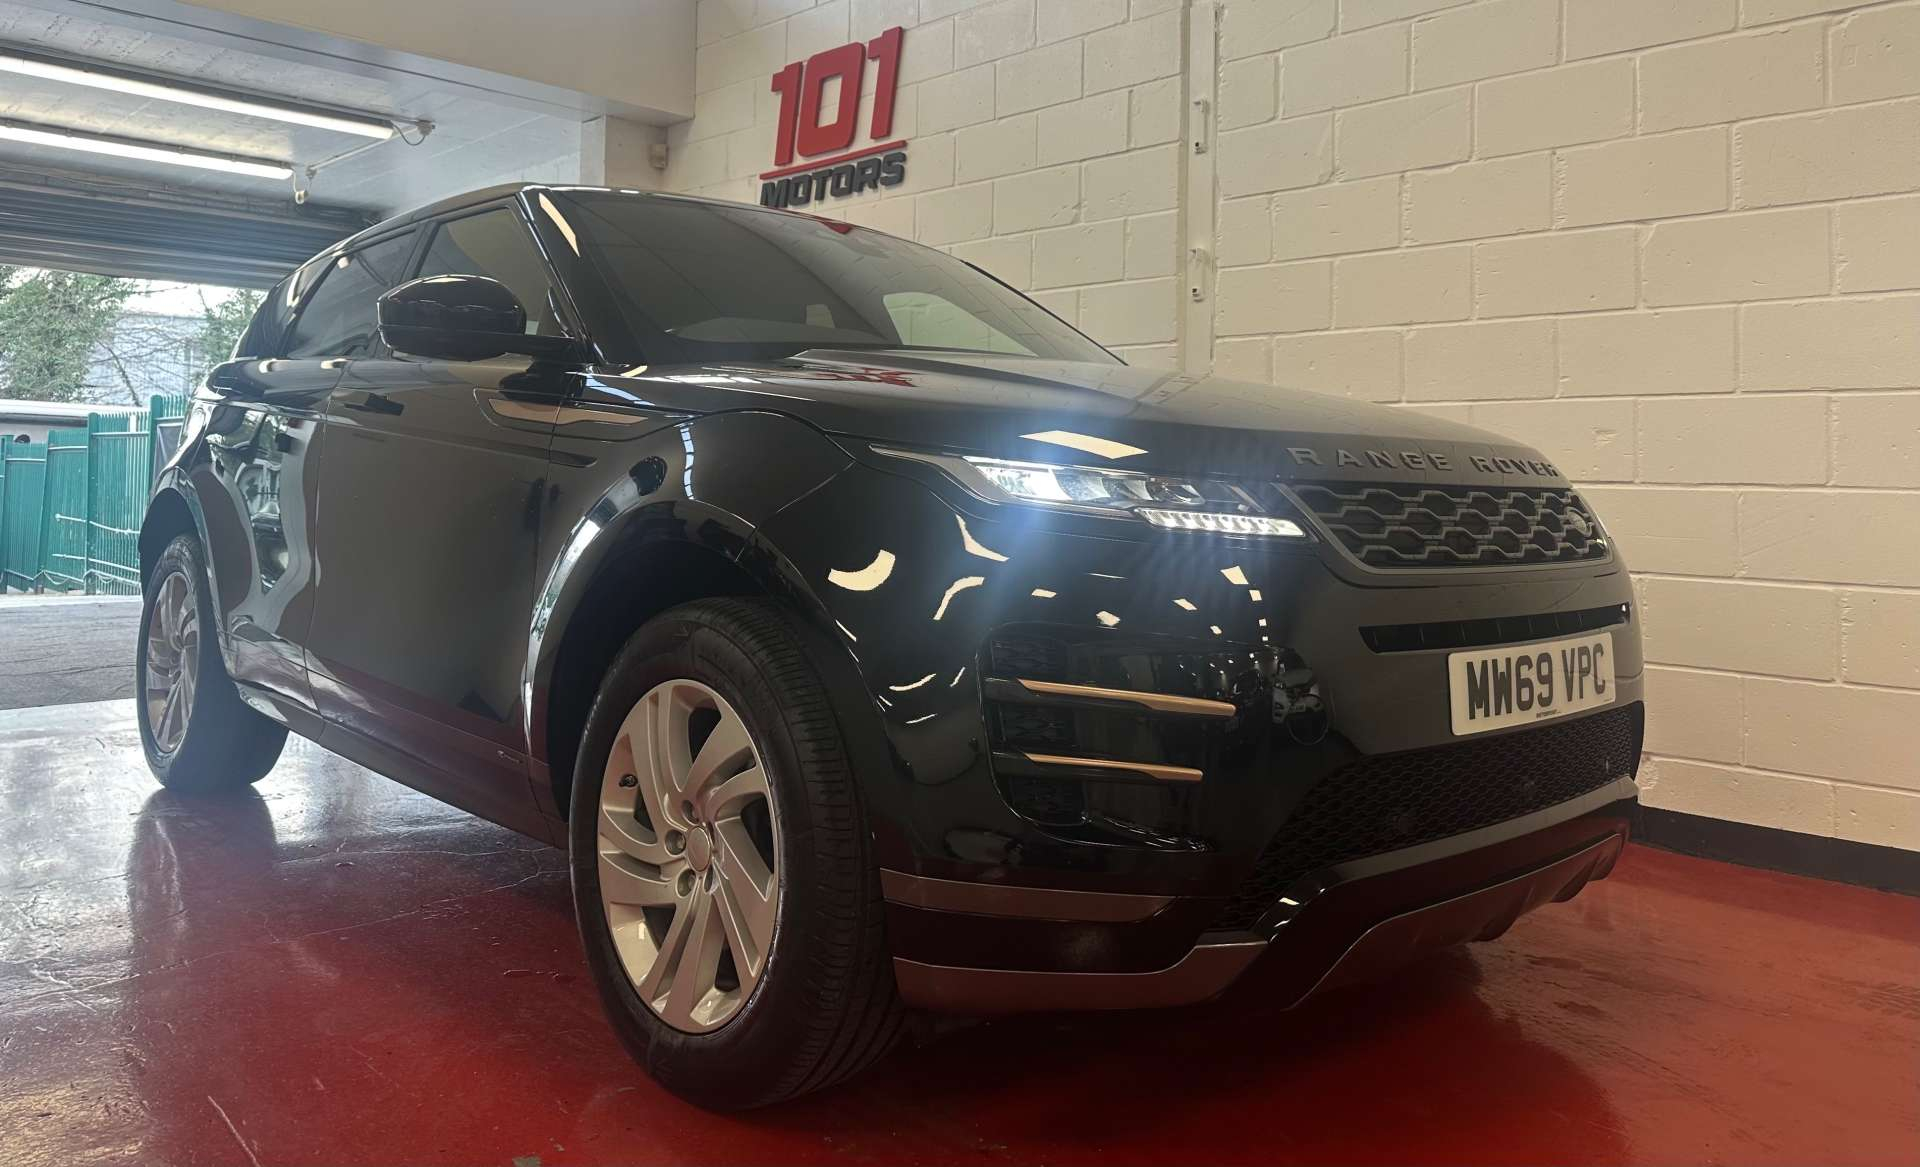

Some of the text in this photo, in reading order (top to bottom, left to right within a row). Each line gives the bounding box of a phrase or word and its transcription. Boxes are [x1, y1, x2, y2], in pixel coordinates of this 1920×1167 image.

[771, 26, 904, 167] 101
[760, 151, 907, 208] MOTORS
[1287, 447, 1560, 477] RANGE ROVER
[1466, 643, 1606, 720] MW69 VPC
